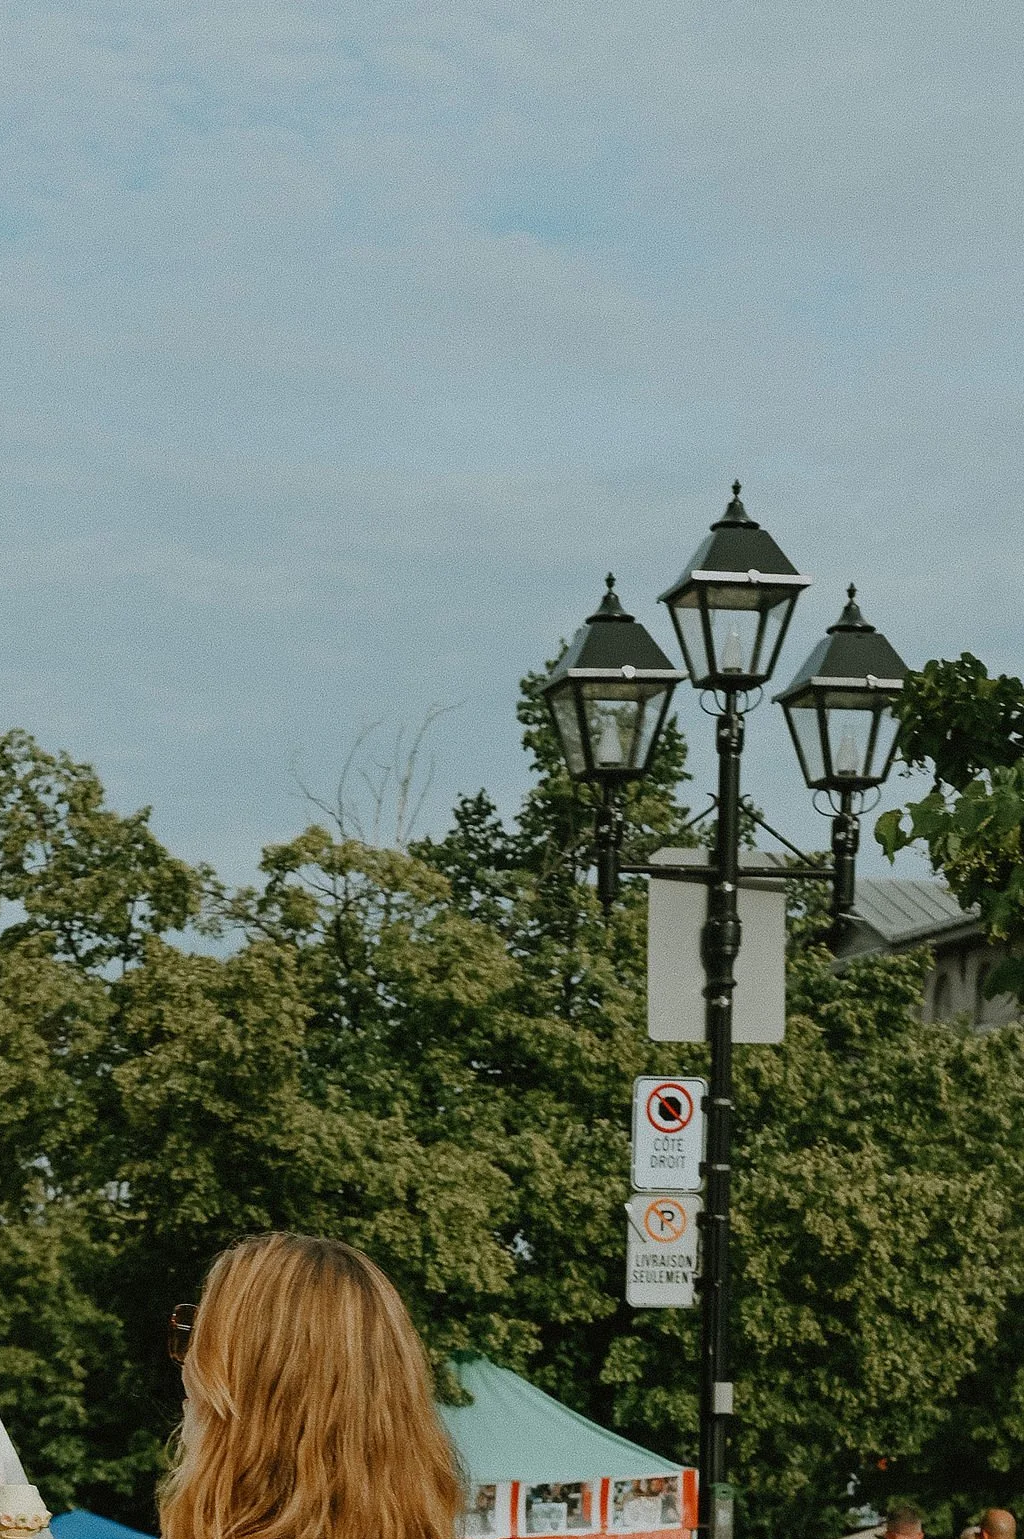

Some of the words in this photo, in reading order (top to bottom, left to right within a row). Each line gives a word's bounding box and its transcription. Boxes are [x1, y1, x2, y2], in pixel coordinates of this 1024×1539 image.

[654, 1136, 683, 1152] CÔTE
[650, 1154, 685, 1168] DROIT
[635, 1254, 692, 1268] LIVRAISON
